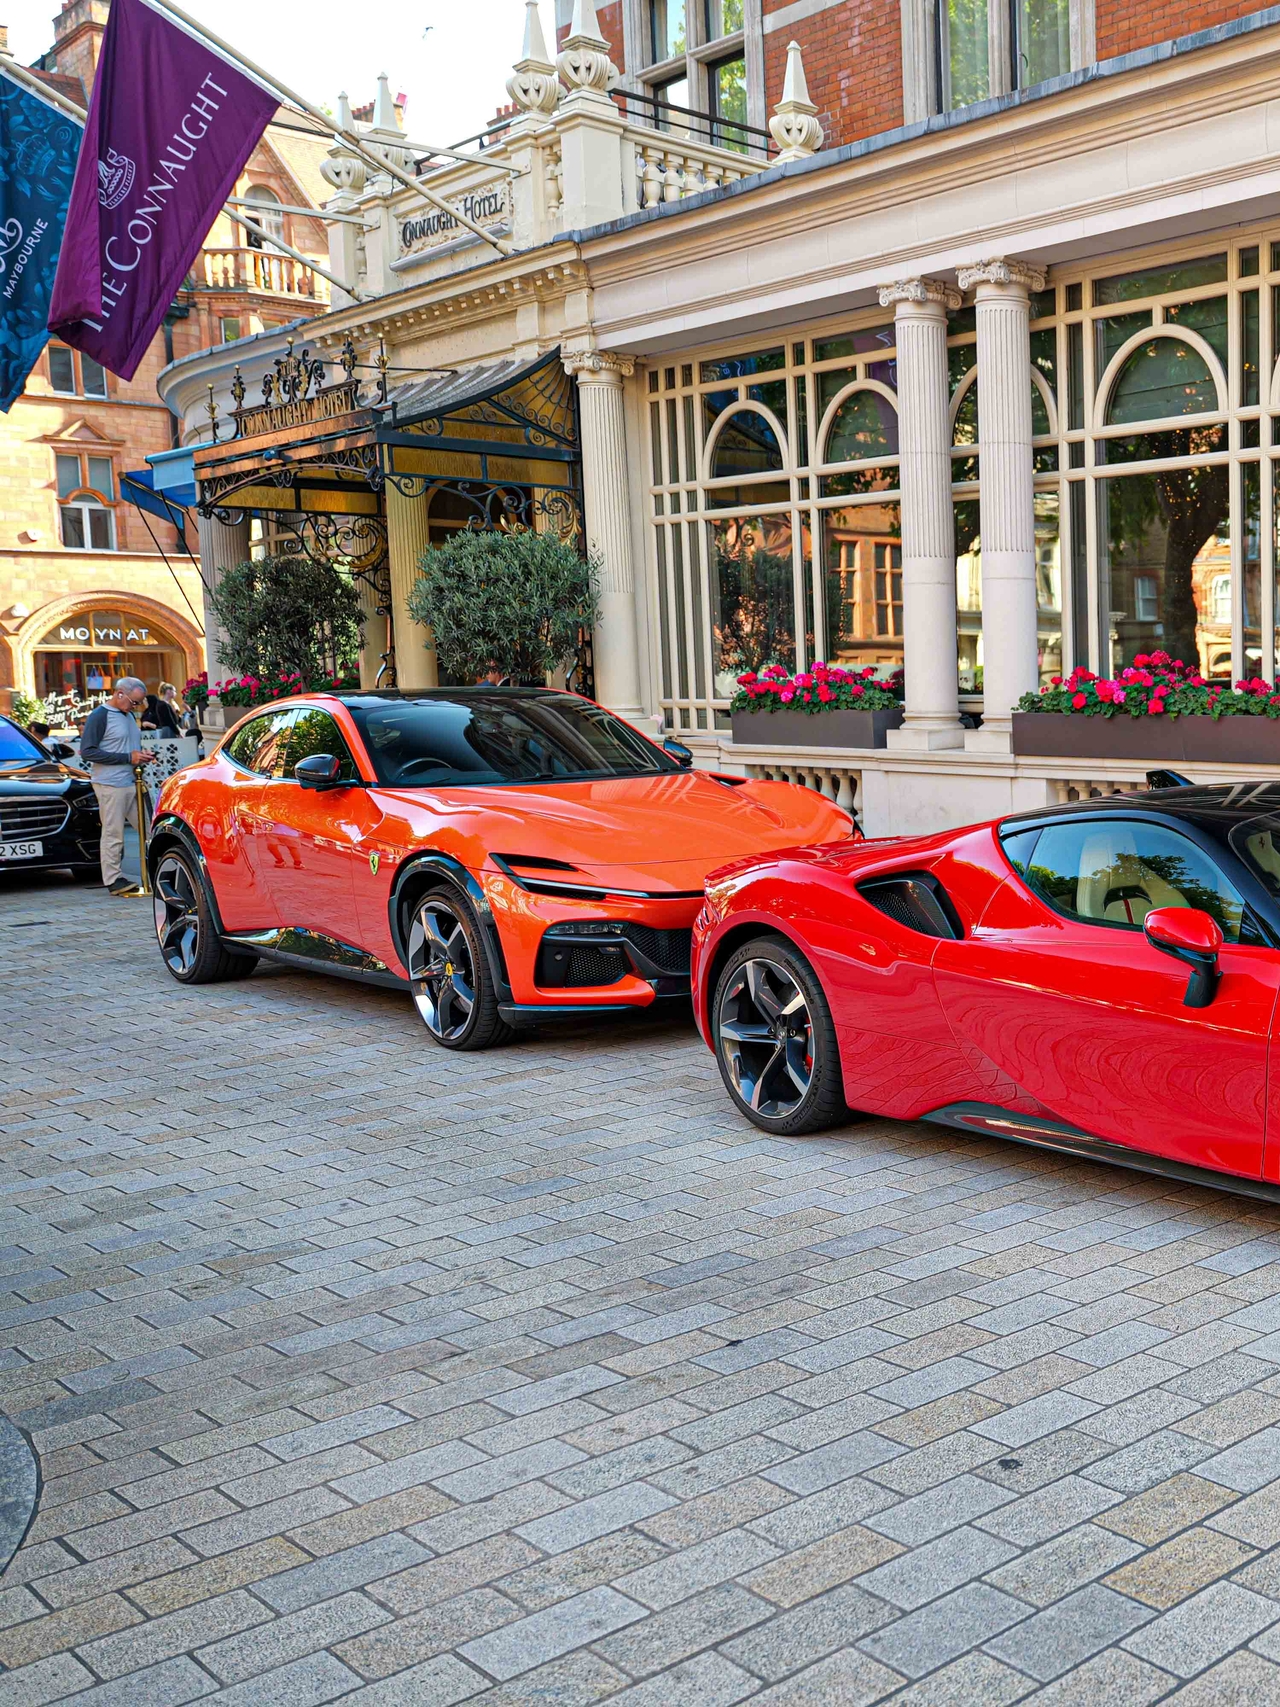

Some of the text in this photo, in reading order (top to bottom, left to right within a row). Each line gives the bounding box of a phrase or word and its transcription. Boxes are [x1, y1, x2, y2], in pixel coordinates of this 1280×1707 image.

[106, 72, 228, 272] CONNAUGHT
[464, 193, 505, 226] HOTEL
[3, 218, 48, 298] MAYBOURNE
[60, 627, 149, 640] MOYNAT
[9, 843, 36, 856] XSG
